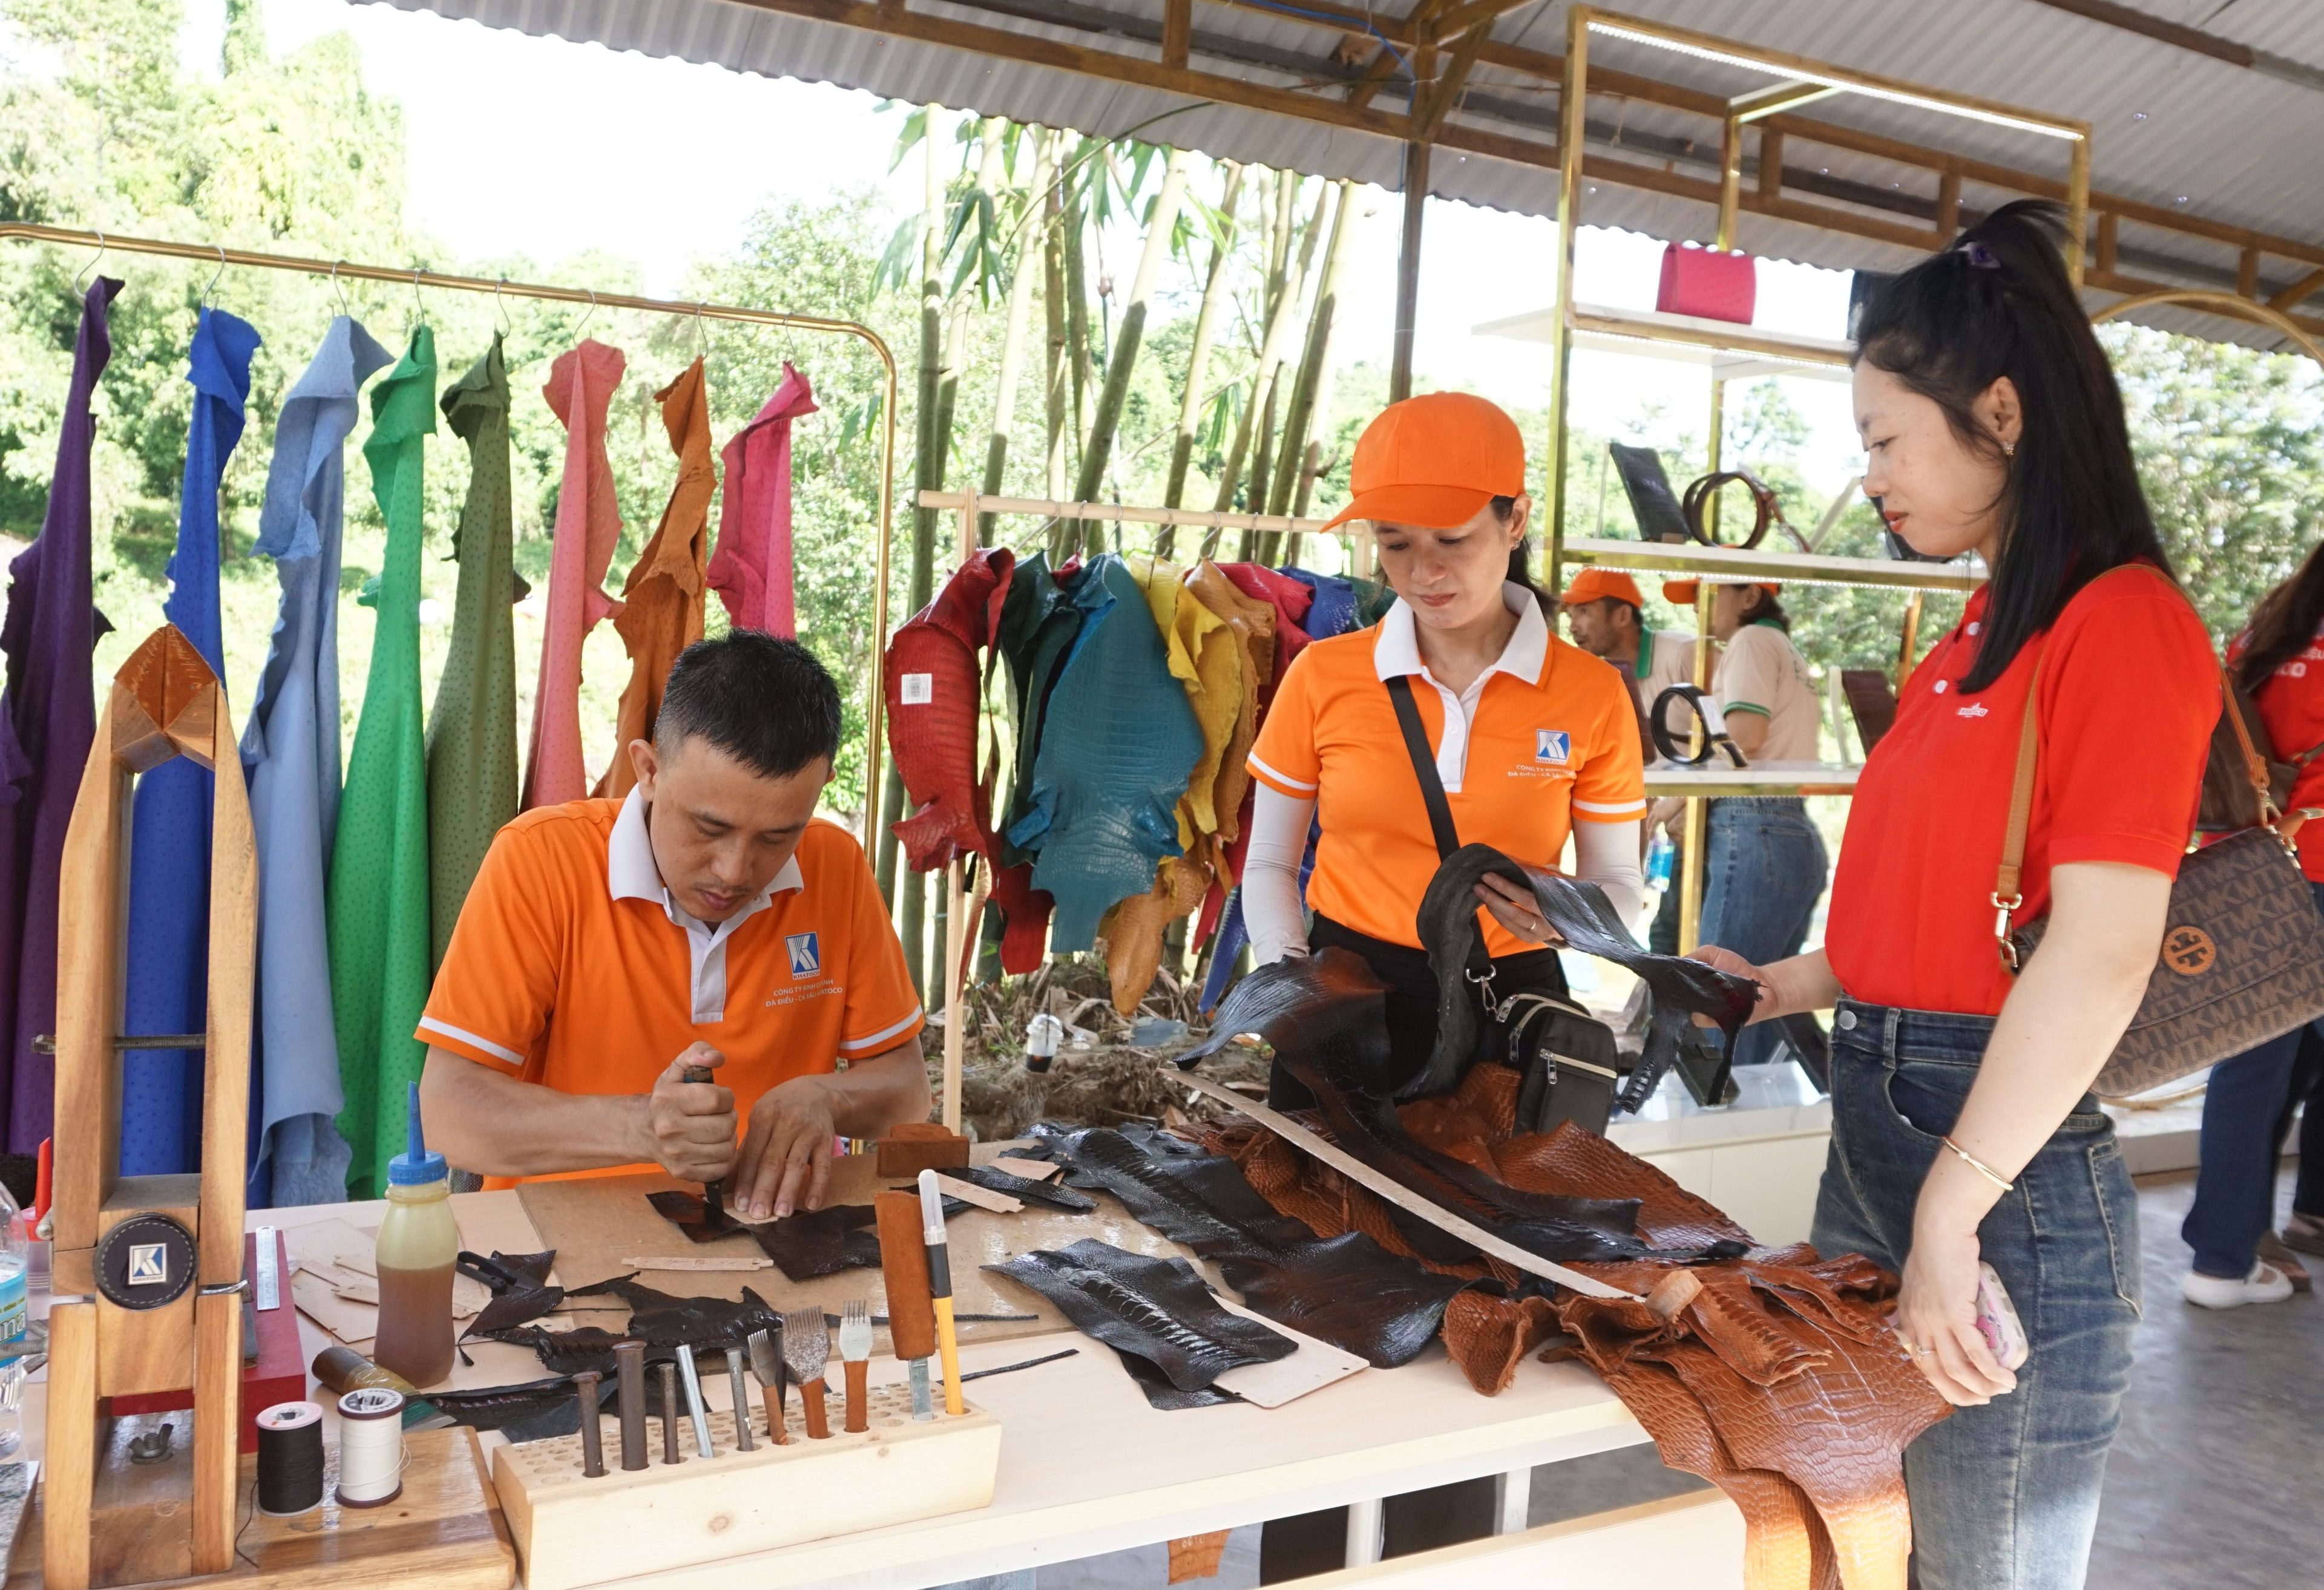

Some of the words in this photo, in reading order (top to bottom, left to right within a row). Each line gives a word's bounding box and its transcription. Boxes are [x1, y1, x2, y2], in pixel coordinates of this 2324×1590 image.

[793, 971, 819, 980] KHATOCO
[773, 987, 793, 996] CÔNG
[816, 979, 833, 989] DNH
[817, 987, 843, 996] KATOCO
[0, 1312, 26, 1341] na
